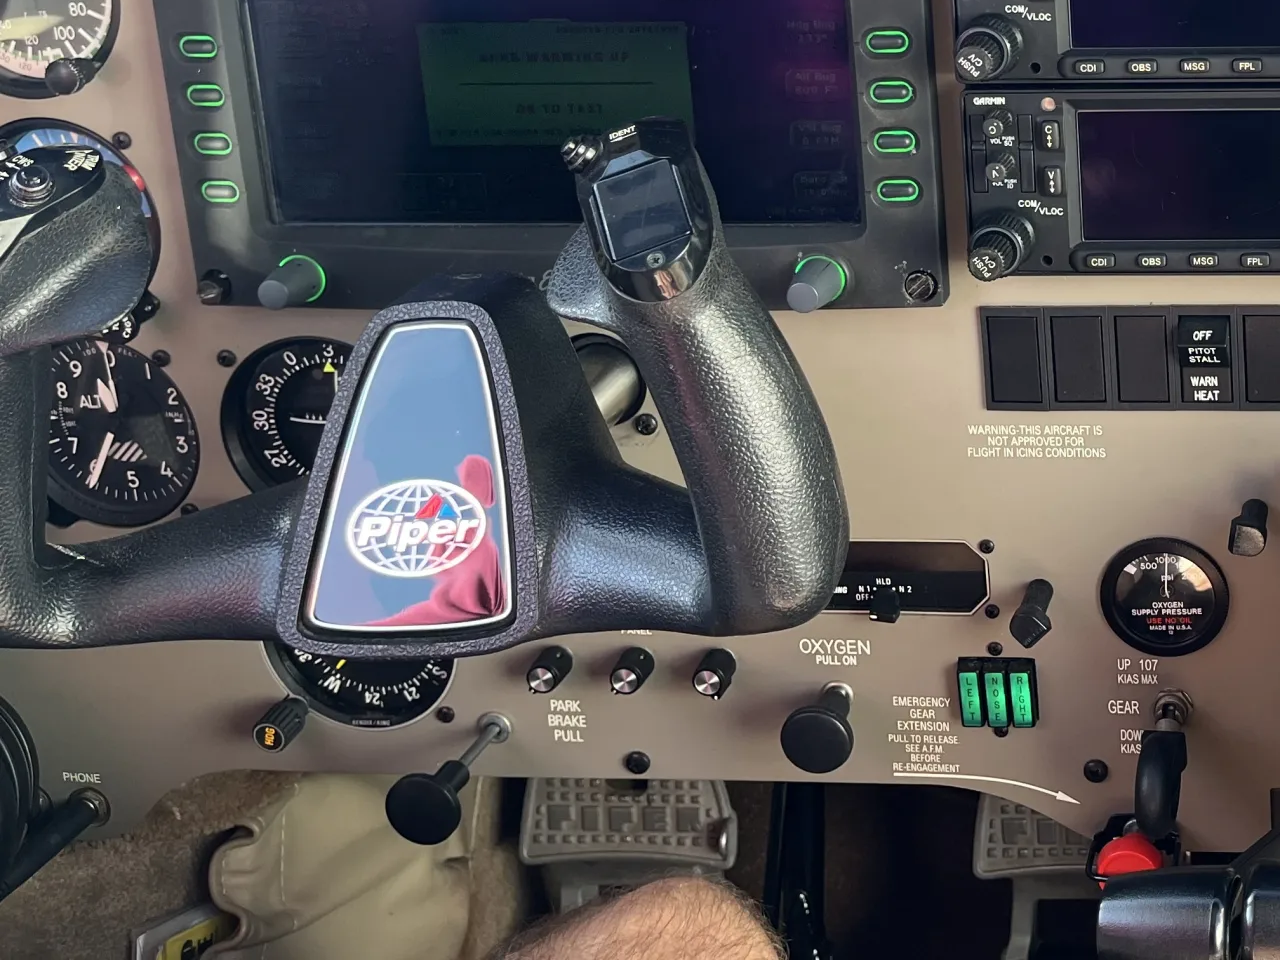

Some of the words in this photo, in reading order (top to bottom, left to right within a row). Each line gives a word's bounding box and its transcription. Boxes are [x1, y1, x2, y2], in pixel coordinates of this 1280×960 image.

[1080, 64, 1096, 72] CDI
[1132, 63, 1151, 71] OBS
[1184, 62, 1205, 70] MSG
[1239, 62, 1255, 70] FPL
[1193, 331, 1212, 340] OFF
[1190, 376, 1218, 386] WARN
[1194, 390, 1219, 400] HEAT
[1044, 425, 1090, 435] AIRCRAFT
[1093, 425, 1102, 435] IS
[988, 436, 1008, 446] NOT
[1011, 436, 1062, 446] APPROVED
[1065, 437, 1084, 446] FOR
[968, 446, 1001, 457] FLIGHT
[1004, 448, 1013, 457] IN
[1016, 448, 1043, 457] ICING
[1045, 448, 1106, 457] CONDITIONS
[357, 514, 481, 554] Piper
[800, 639, 870, 656] OXYGEN
[816, 654, 841, 665] PULL
[842, 654, 857, 665] ON
[1118, 659, 1130, 670] UP
[1139, 659, 1158, 670] 107
[1118, 674, 1139, 684] KIAS
[1141, 674, 1158, 684] MAX
[893, 696, 950, 707] EMERGENCY
[549, 700, 581, 714] PARK
[1108, 700, 1139, 714] GEAR
[910, 709, 935, 719] GEAR
[548, 714, 586, 729] BRAKE
[898, 721, 949, 731] EXTENSION
[554, 728, 584, 742] PULL
[63, 772, 101, 783] PHONE
